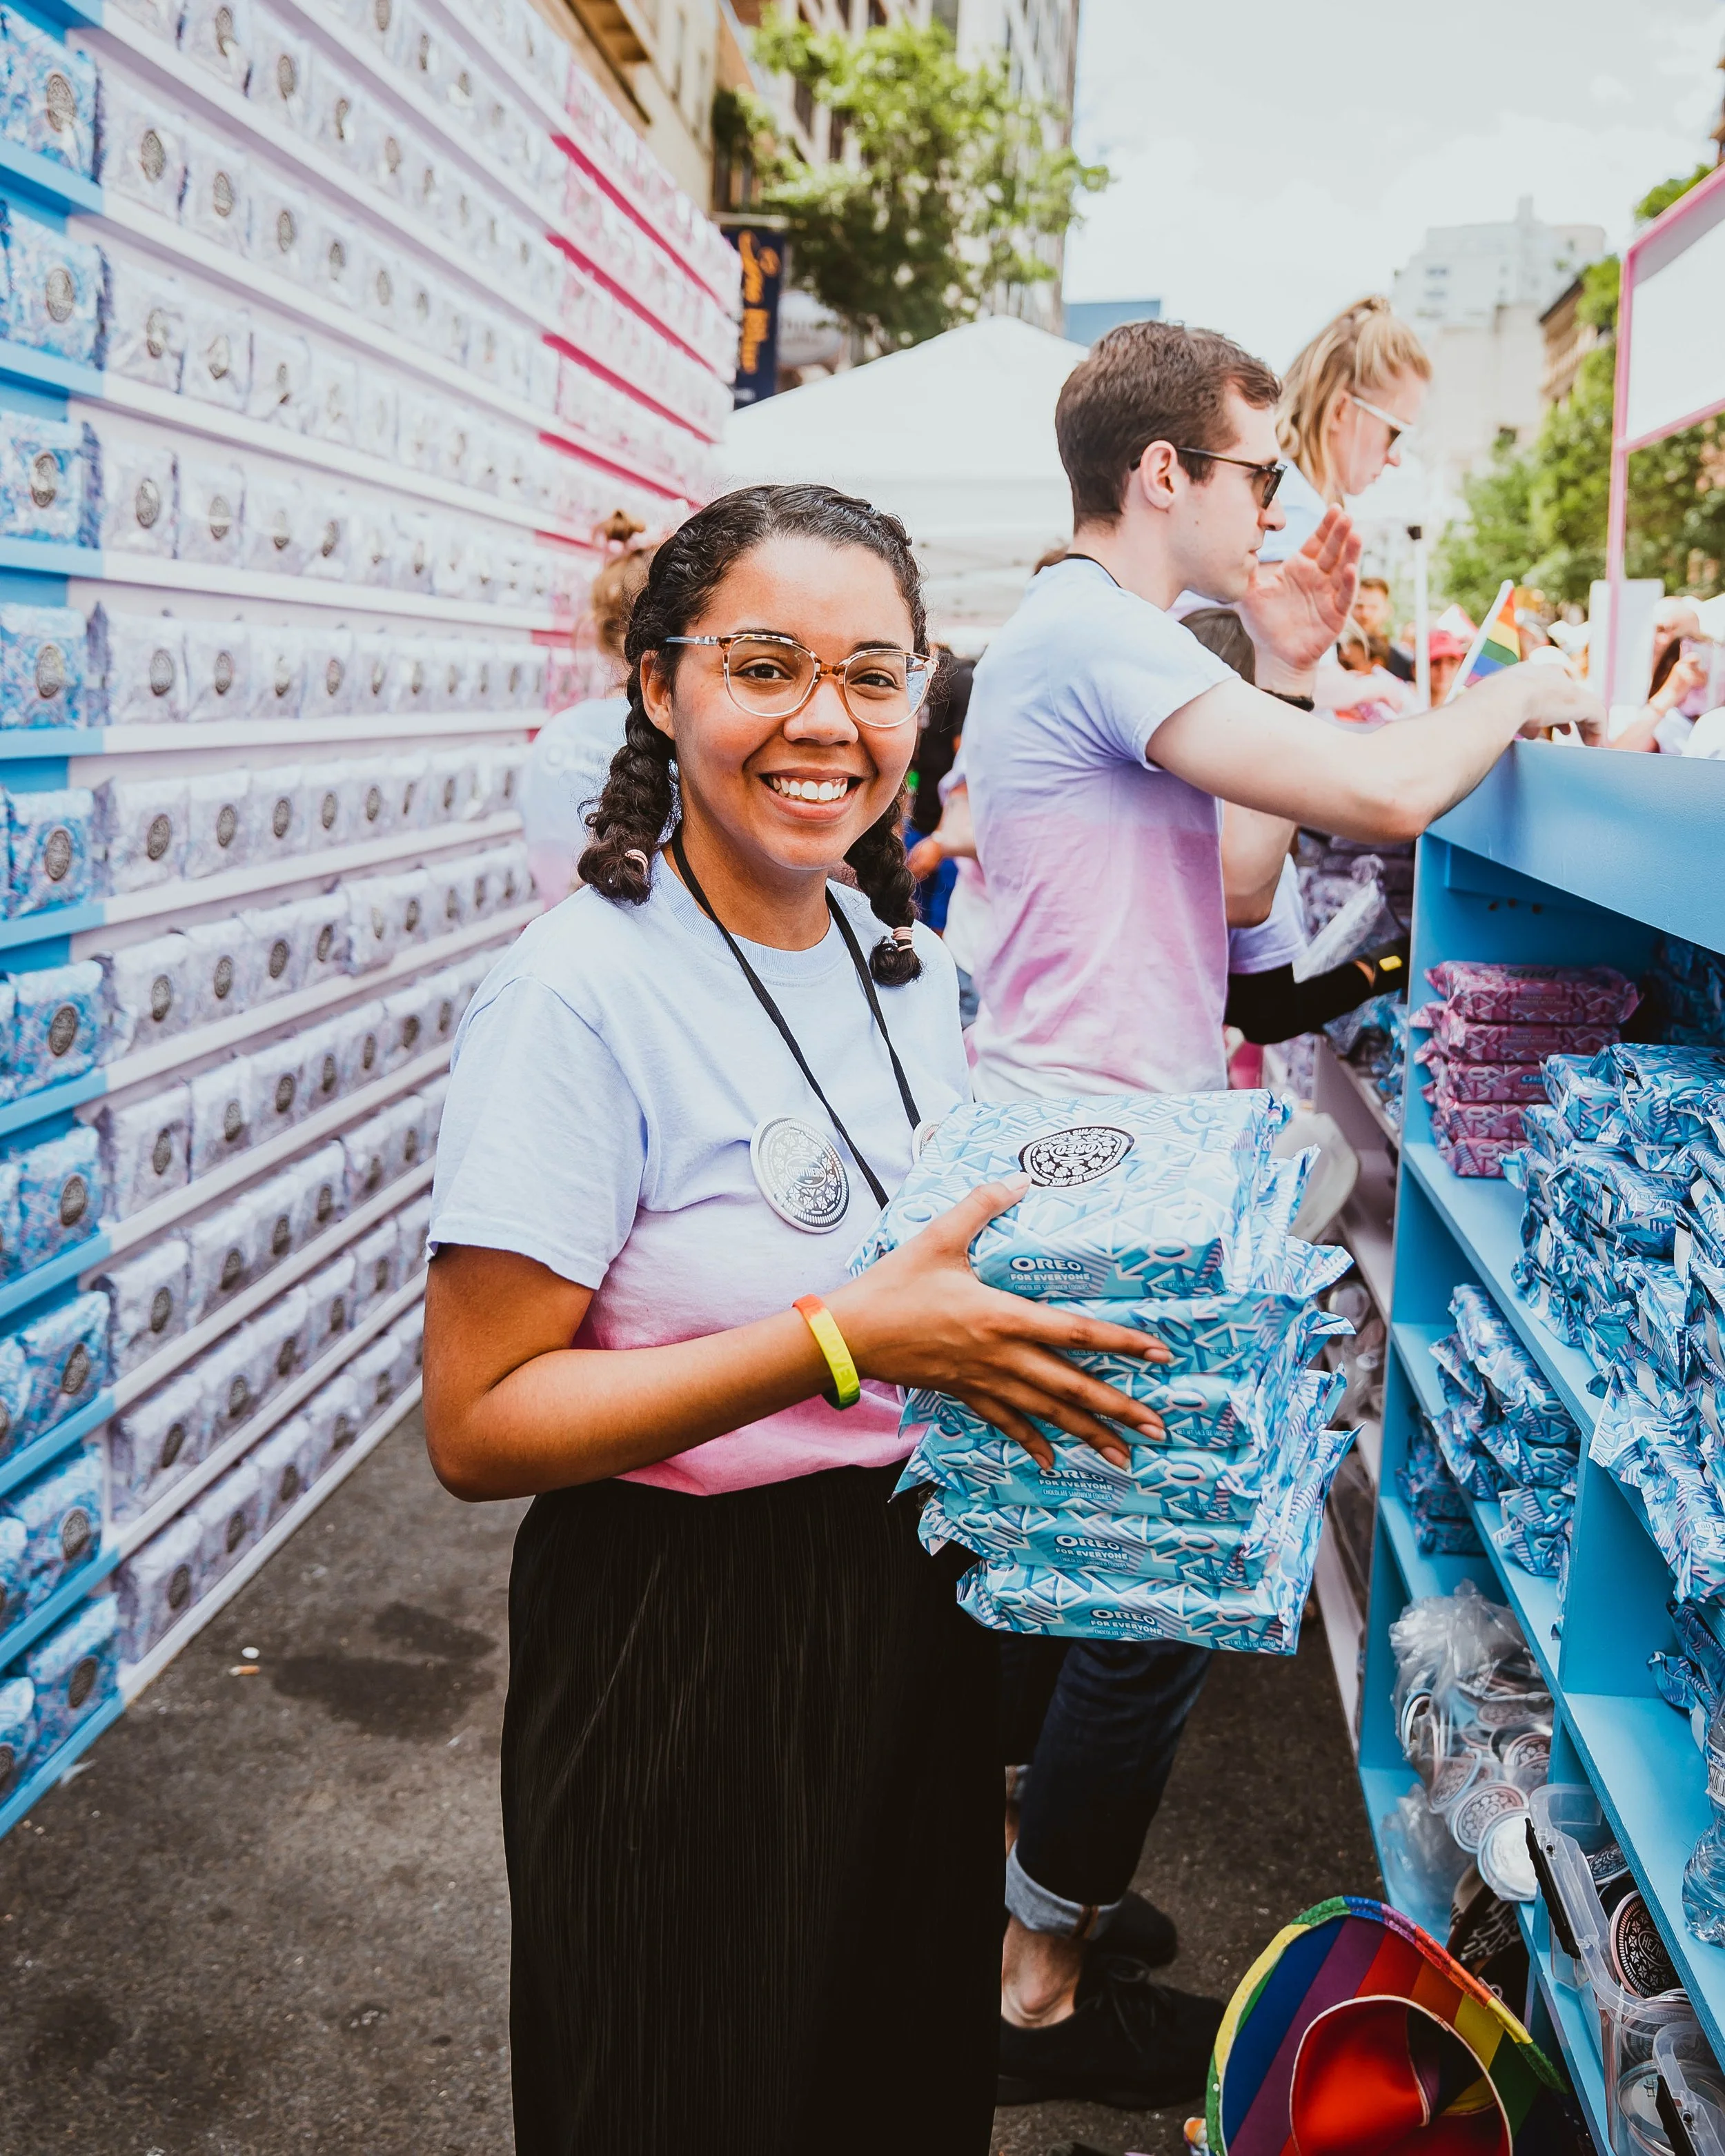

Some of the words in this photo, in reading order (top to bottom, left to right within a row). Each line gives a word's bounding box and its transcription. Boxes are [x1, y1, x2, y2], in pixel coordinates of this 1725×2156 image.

[1055, 1144, 1094, 1156] OREO
[1011, 1256, 1082, 1272] OREO
[1040, 1467, 1104, 1482] OREO
[1061, 1481, 1113, 1490] EVERYONE
[1069, 1490, 1092, 1499] SANDWICH
[1056, 1534, 1120, 1551] OREO
[1076, 1550, 1128, 1560] EVERYONE
[1092, 1609, 1156, 1625] OREO
[1112, 1621, 1163, 1635] EVERYONE
[1642, 1934, 1668, 1963] HE/HIS
